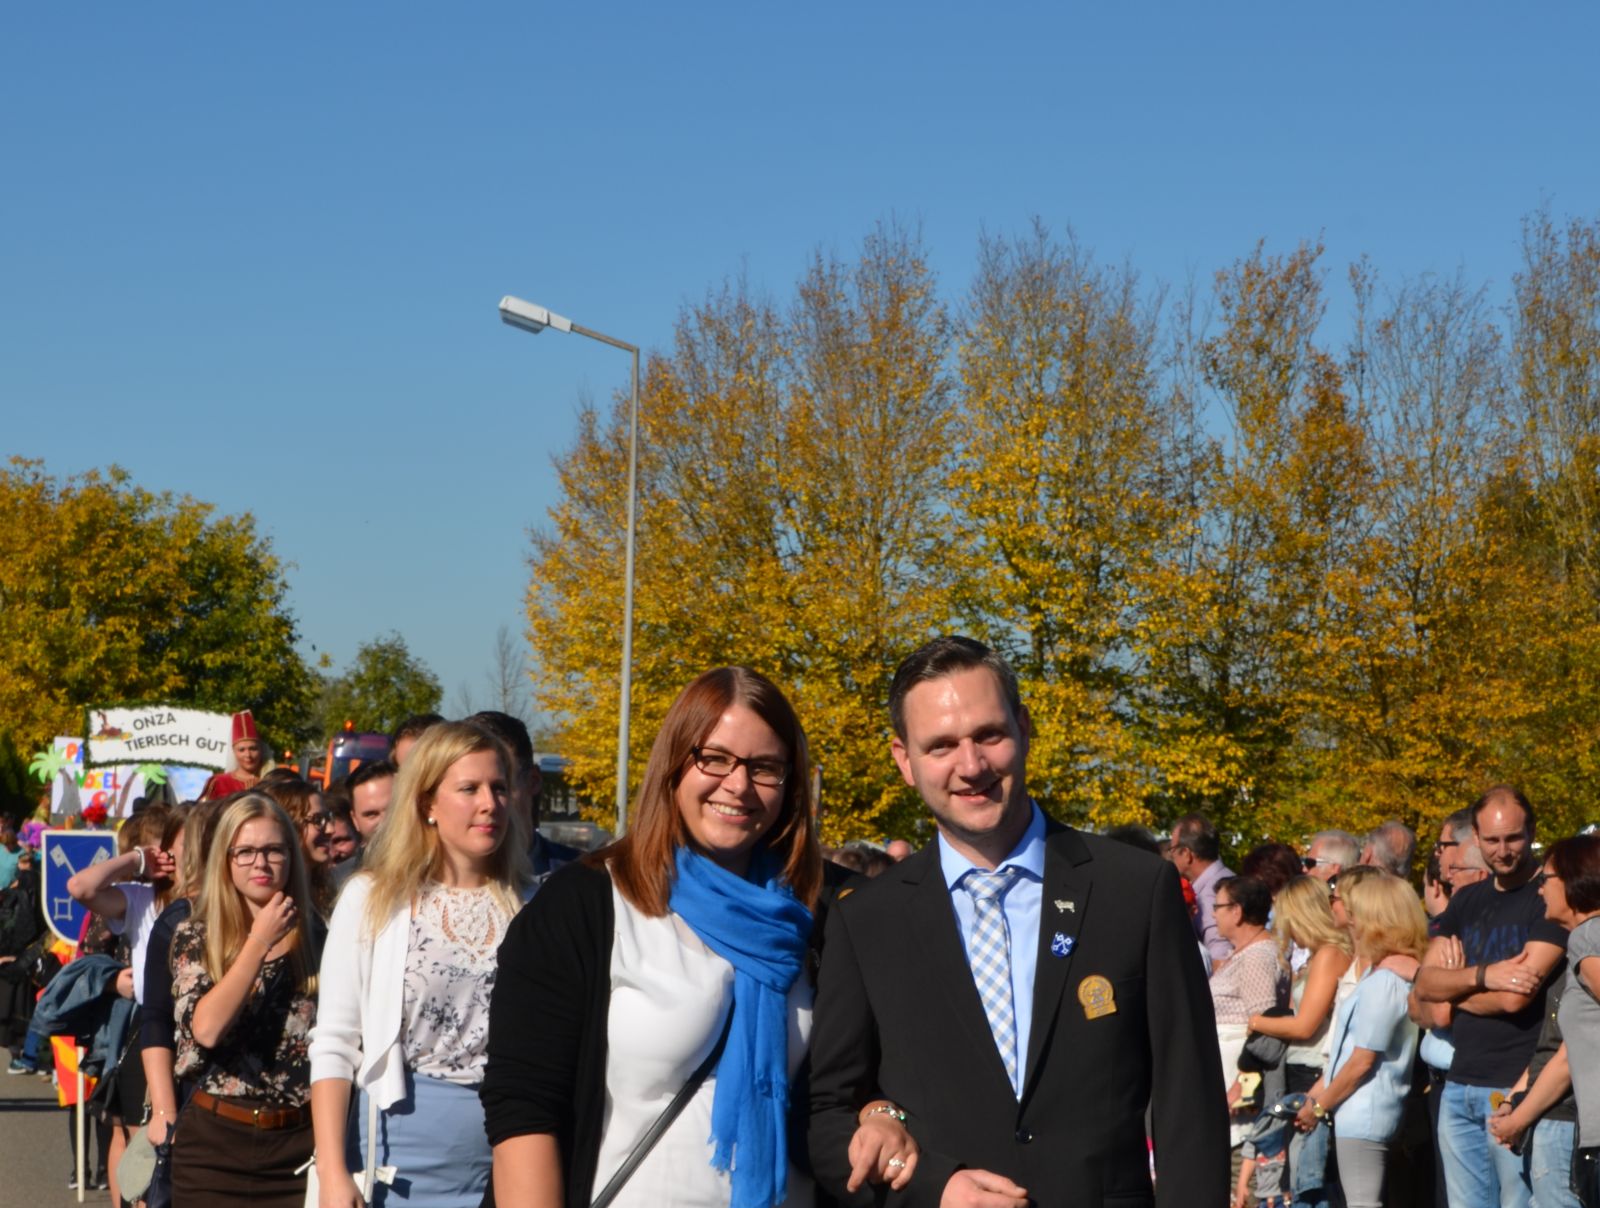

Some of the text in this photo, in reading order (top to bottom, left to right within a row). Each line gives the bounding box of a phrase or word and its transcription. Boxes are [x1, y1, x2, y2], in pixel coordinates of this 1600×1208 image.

[133, 712, 177, 731] ONZA
[124, 734, 227, 754] TIERISCH GUT
